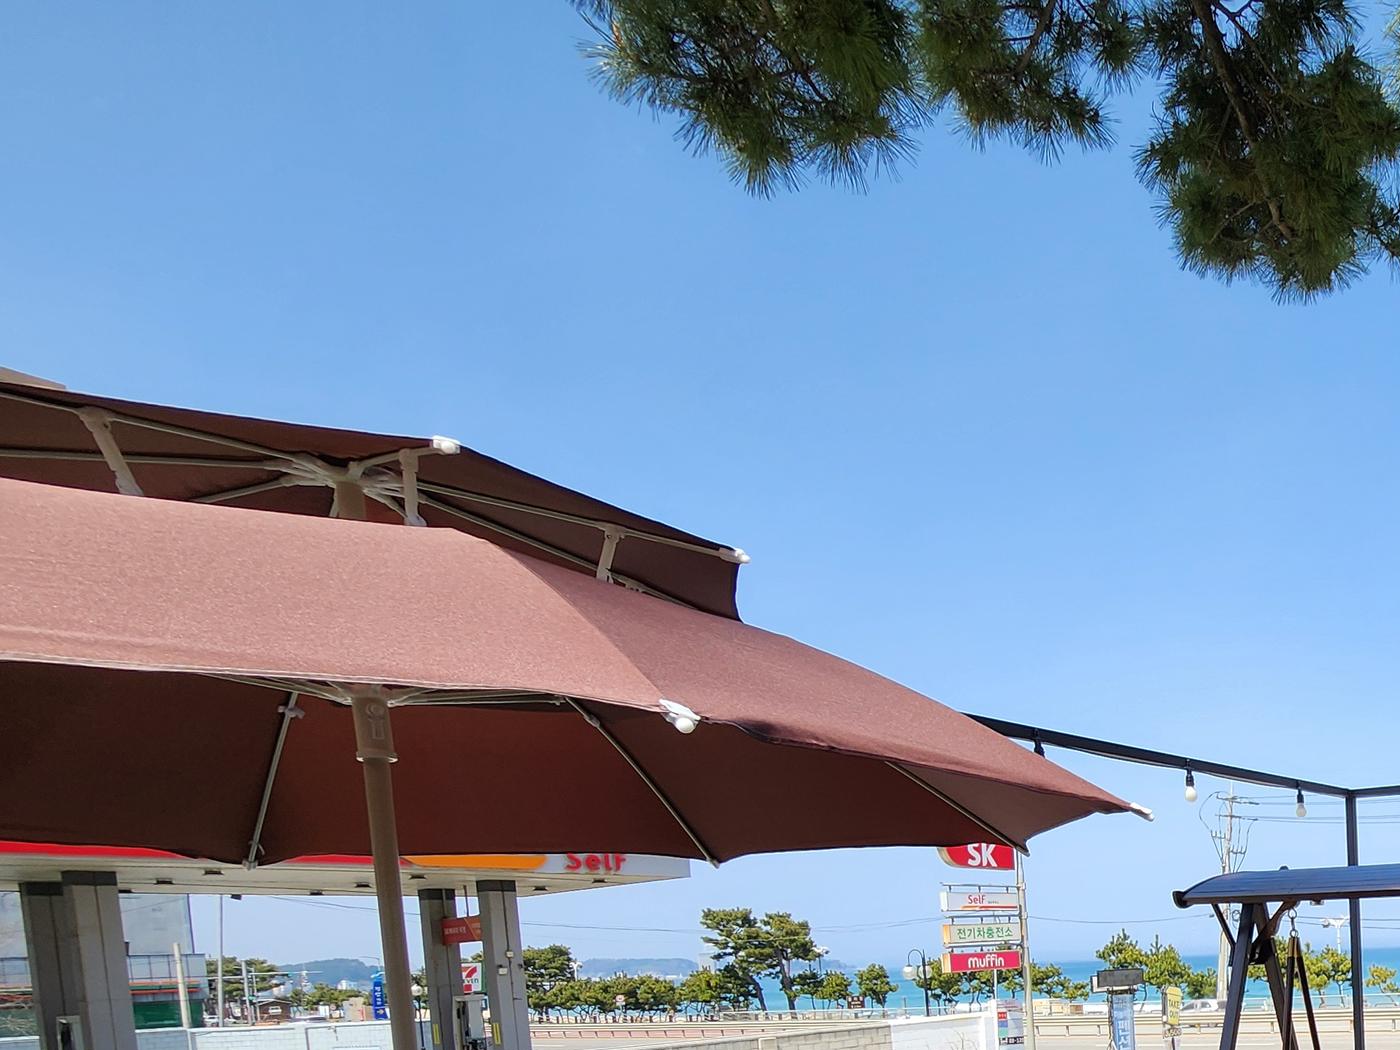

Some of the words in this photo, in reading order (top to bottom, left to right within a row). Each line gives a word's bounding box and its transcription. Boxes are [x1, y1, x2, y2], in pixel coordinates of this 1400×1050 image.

[967, 843, 998, 867] SK
[968, 894, 986, 904] Self
[957, 926, 1013, 941] 전기차충전소
[968, 953, 1005, 969] muffin
